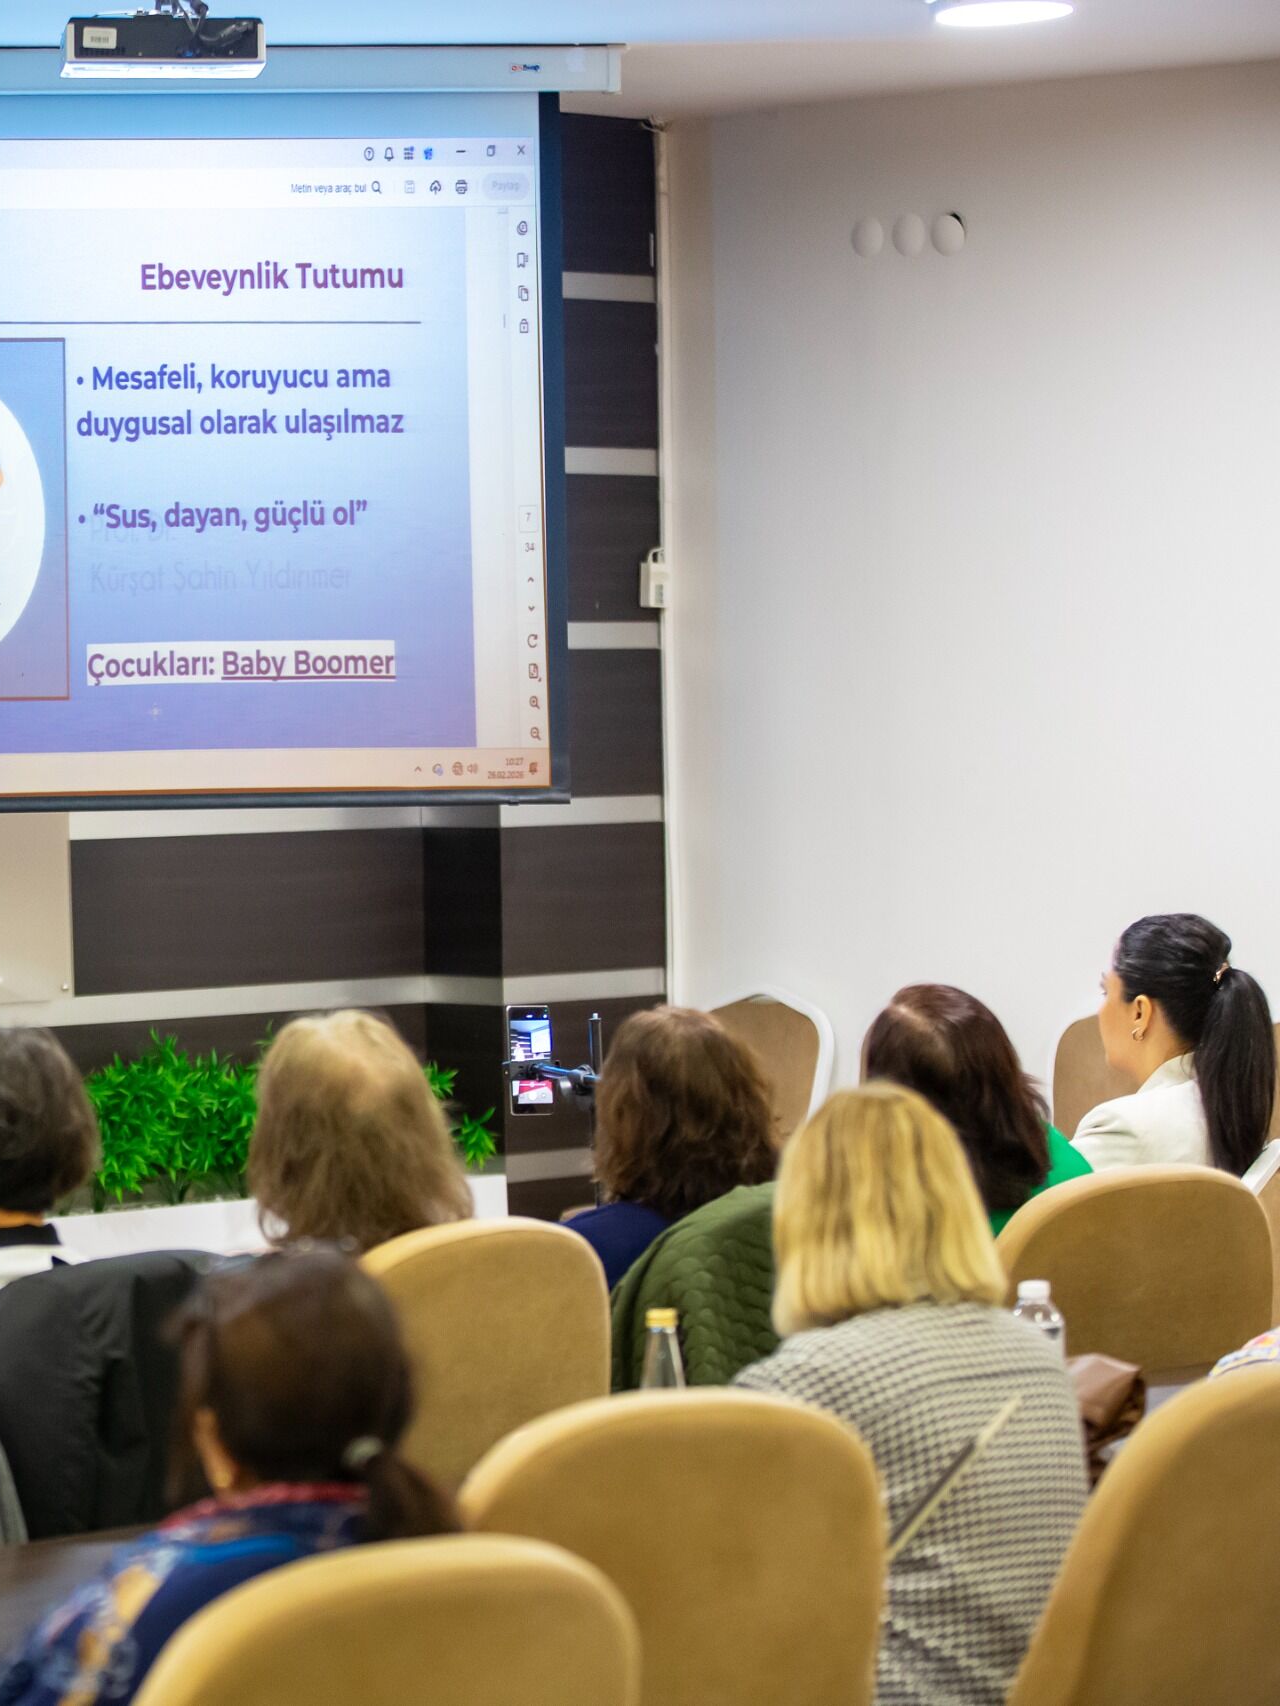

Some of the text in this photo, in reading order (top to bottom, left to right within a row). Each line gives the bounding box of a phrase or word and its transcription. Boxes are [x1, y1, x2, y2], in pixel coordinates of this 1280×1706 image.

[140, 260, 404, 296] Ebeveynlik Tutumu
[92, 362, 391, 395] Mesafeli, koruyucu ama
[76, 408, 405, 442] duygusal olarak ulaşılmaz
[93, 500, 368, 533] “Sus, dayan, güçlü ol”
[525, 512, 532, 522] 7
[524, 542, 536, 552] 34
[87, 650, 396, 687] Çocukları: Baby Boomer
